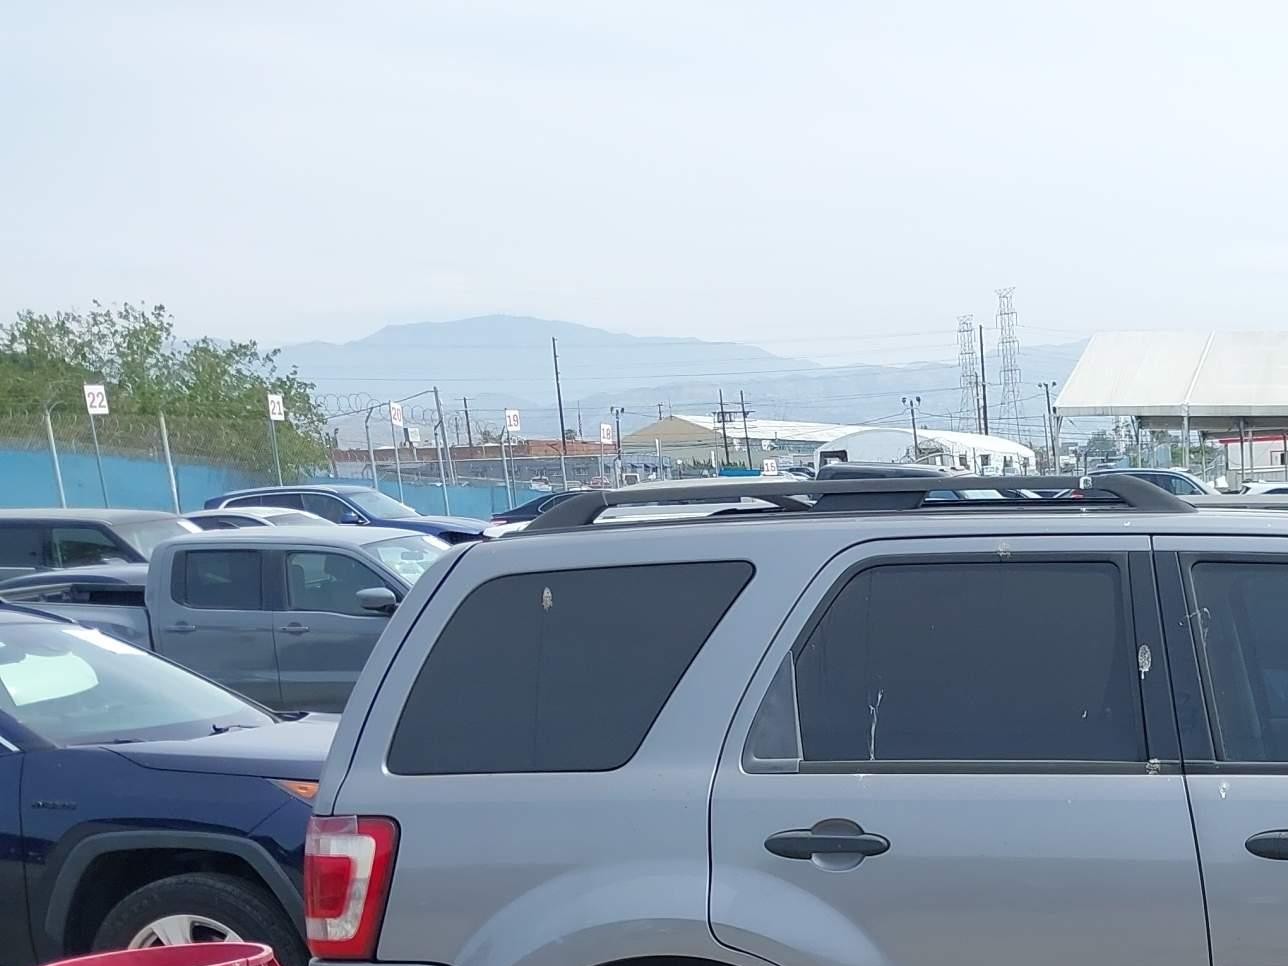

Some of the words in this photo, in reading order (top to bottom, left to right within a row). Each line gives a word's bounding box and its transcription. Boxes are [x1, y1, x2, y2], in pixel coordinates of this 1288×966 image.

[87, 391, 106, 409] 22
[270, 400, 283, 416] 21
[391, 406, 402, 422] 20
[507, 414, 519, 427] 19
